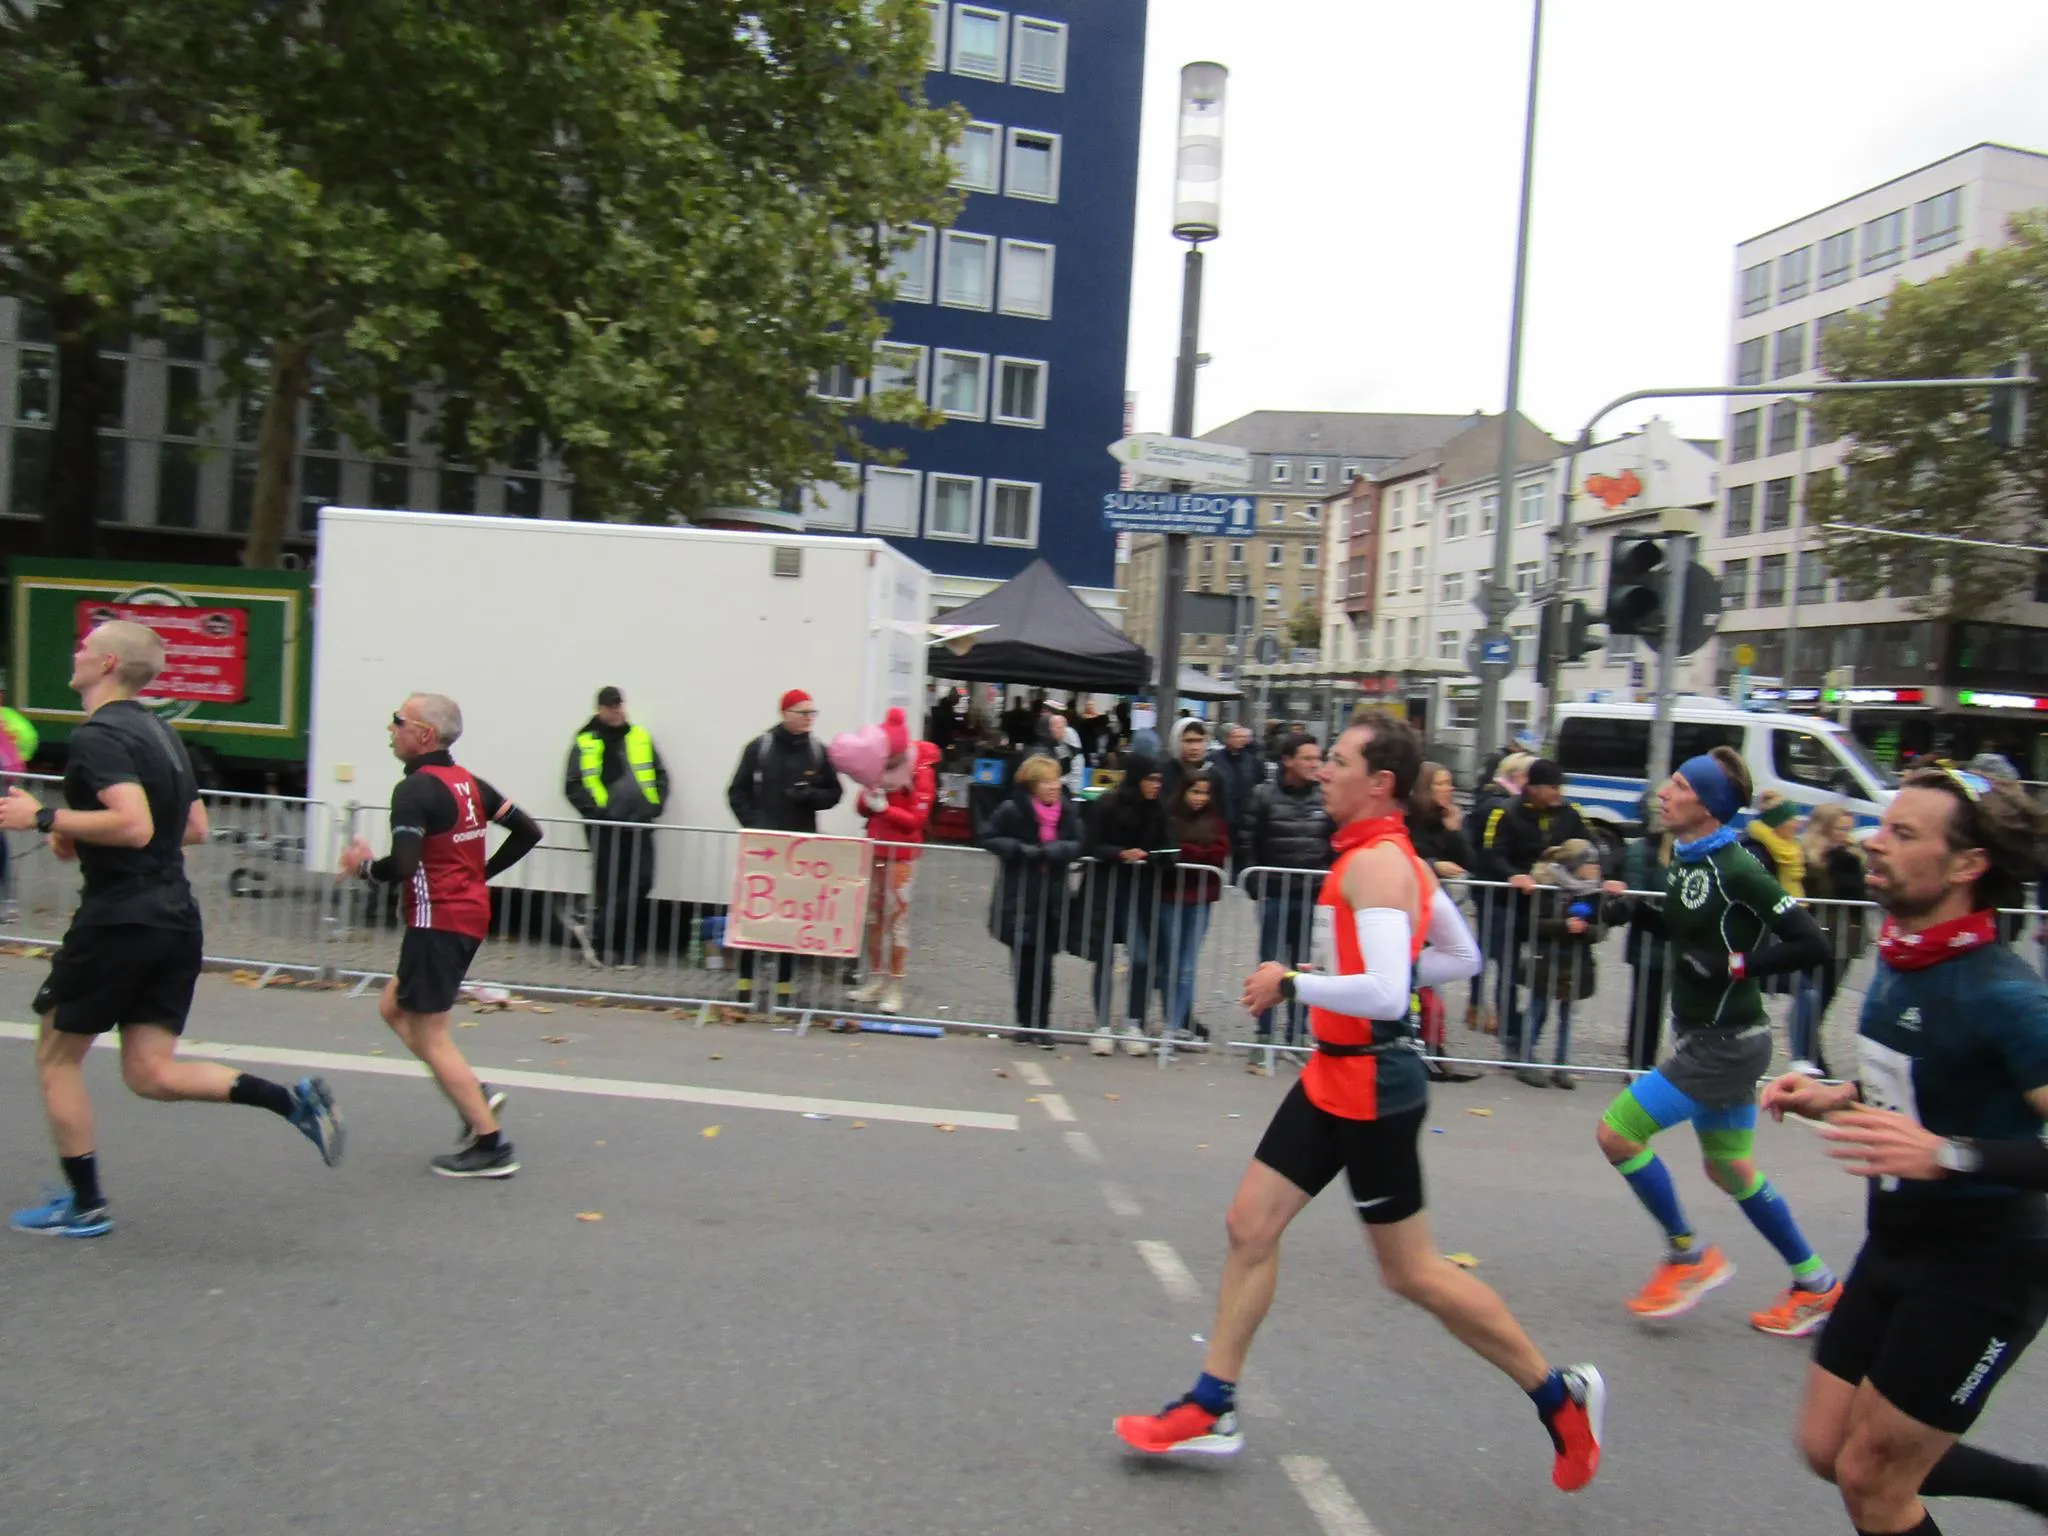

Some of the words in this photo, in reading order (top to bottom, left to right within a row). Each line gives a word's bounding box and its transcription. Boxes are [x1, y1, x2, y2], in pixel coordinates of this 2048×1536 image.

[1103, 492, 1177, 511] SUSHI
[453, 781, 471, 797] TV
[784, 836, 835, 880] Go
[743, 874, 842, 922] Basti
[795, 923, 844, 950] Go!
